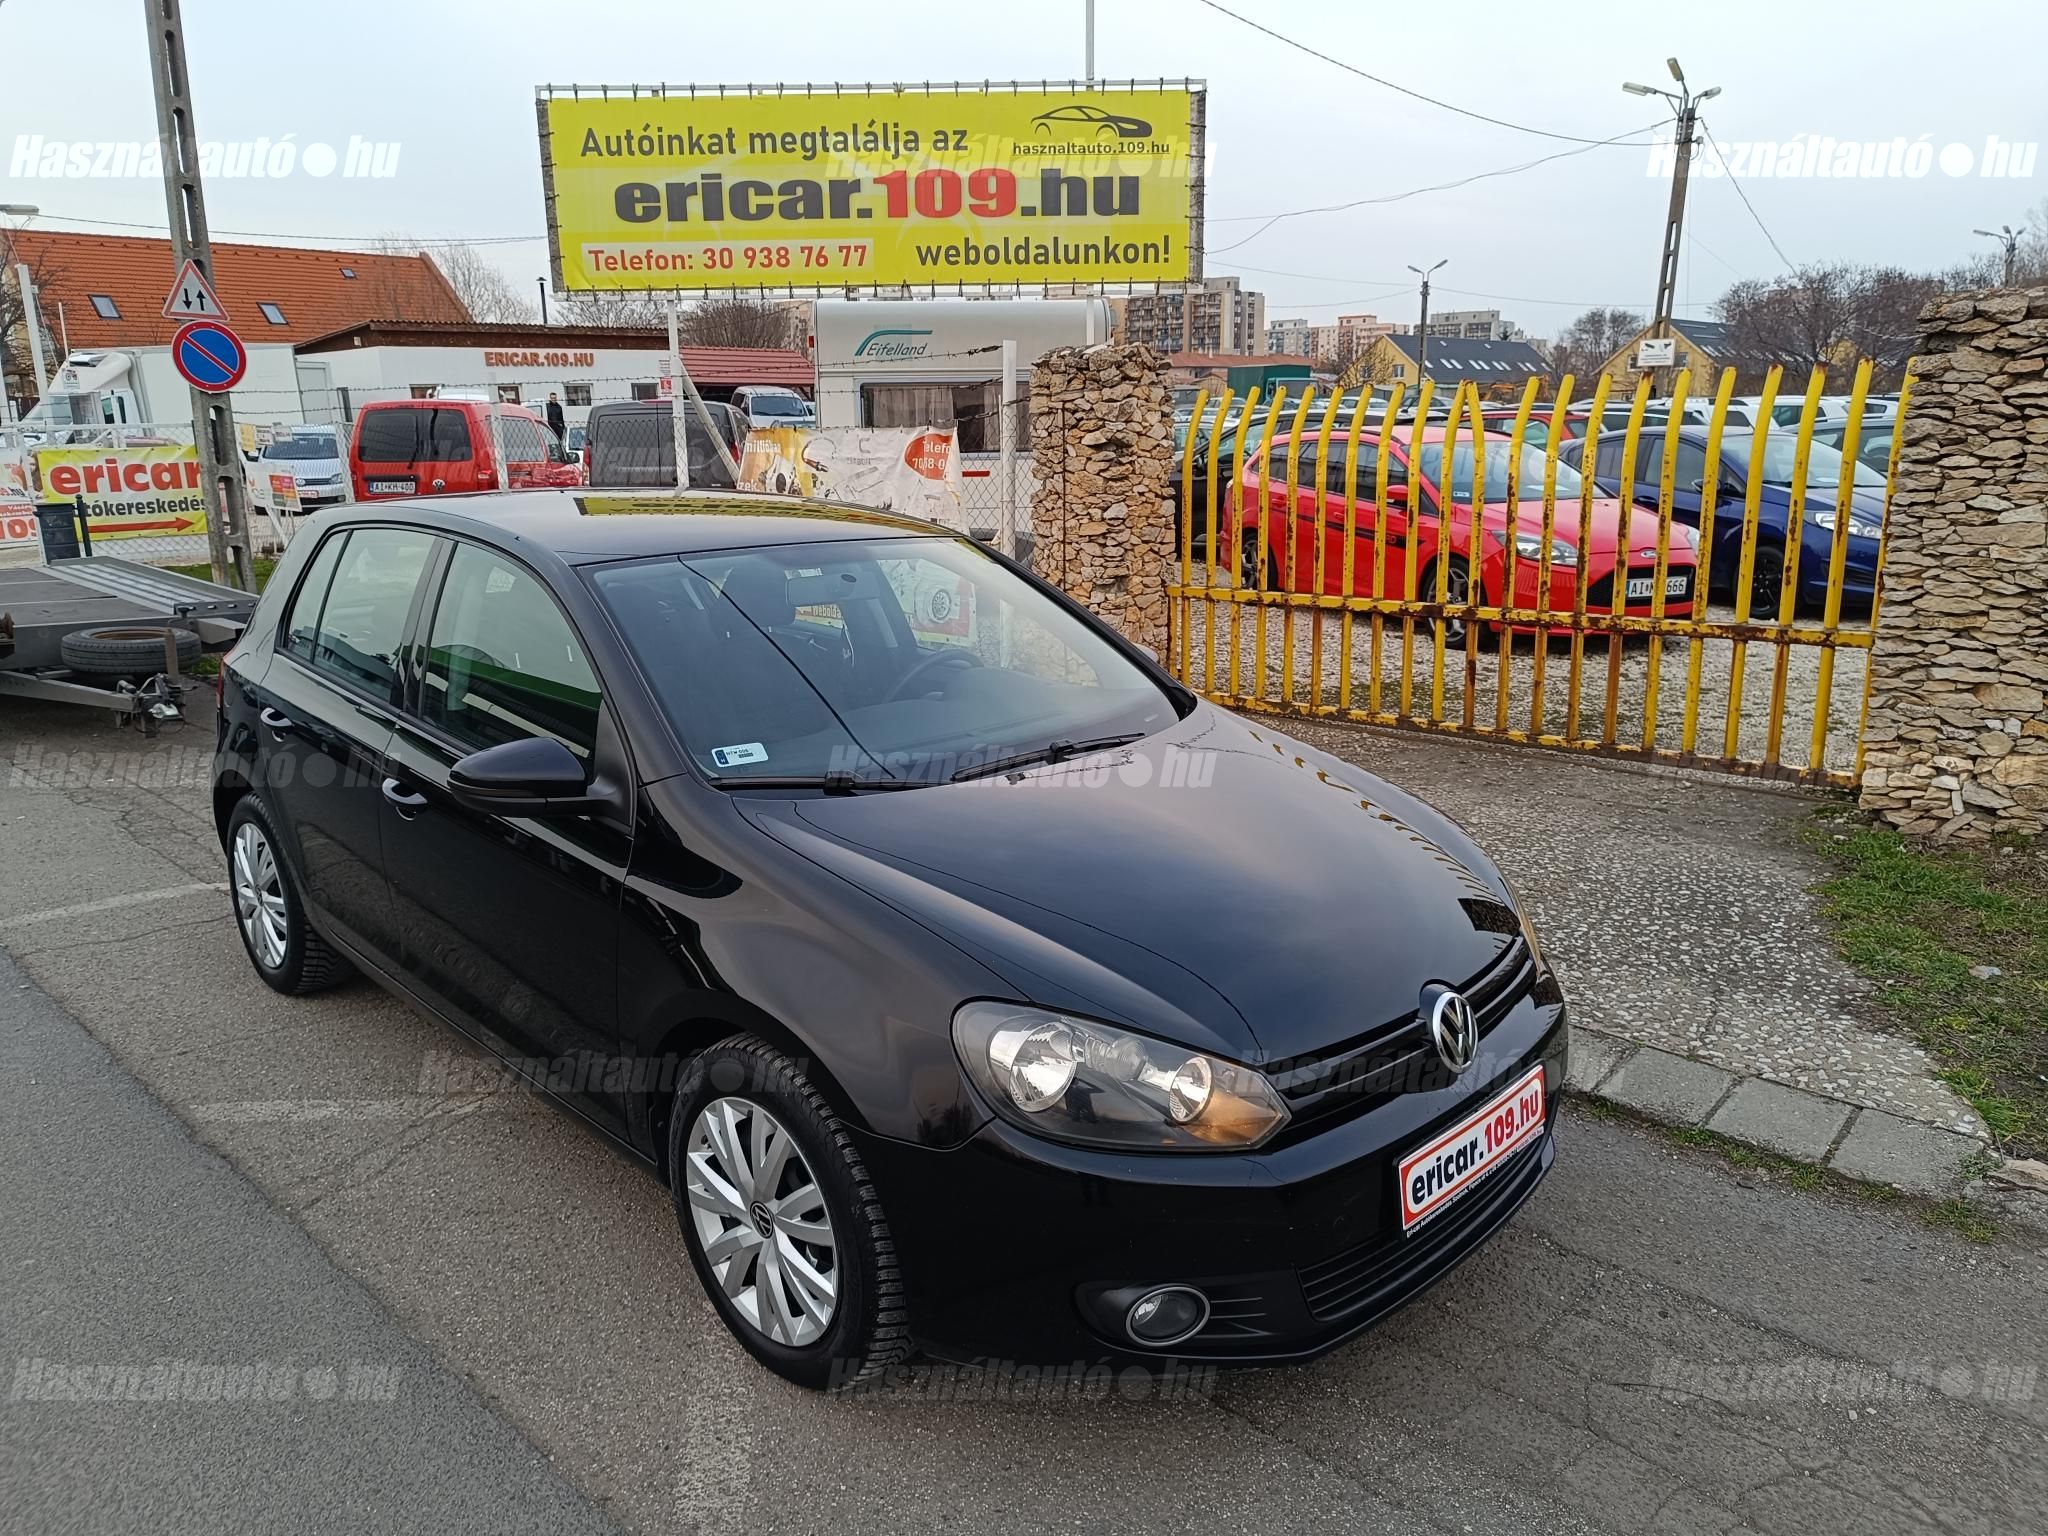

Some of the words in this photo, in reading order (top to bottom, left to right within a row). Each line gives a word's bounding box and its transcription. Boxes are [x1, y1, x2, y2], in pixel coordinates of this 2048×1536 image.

[580, 122, 737, 159] Autóinkat
[748, 118, 920, 164] megtalálja
[932, 125, 969, 153] az
[1012, 140, 1171, 158] hasznaltauto.109.hu
[614, 168, 1140, 225] ericar.109.hu
[587, 245, 694, 274] Telefon:
[702, 247, 736, 270] 30
[743, 247, 791, 269] 938
[799, 246, 830, 268] 76
[838, 244, 868, 267] 77
[915, 233, 1171, 268] weboldalunkon!
[484, 350, 595, 368] ERICAR.109.HU
[866, 341, 929, 357] Eifelland
[1411, 1089, 1539, 1206] ericar.109.hu
